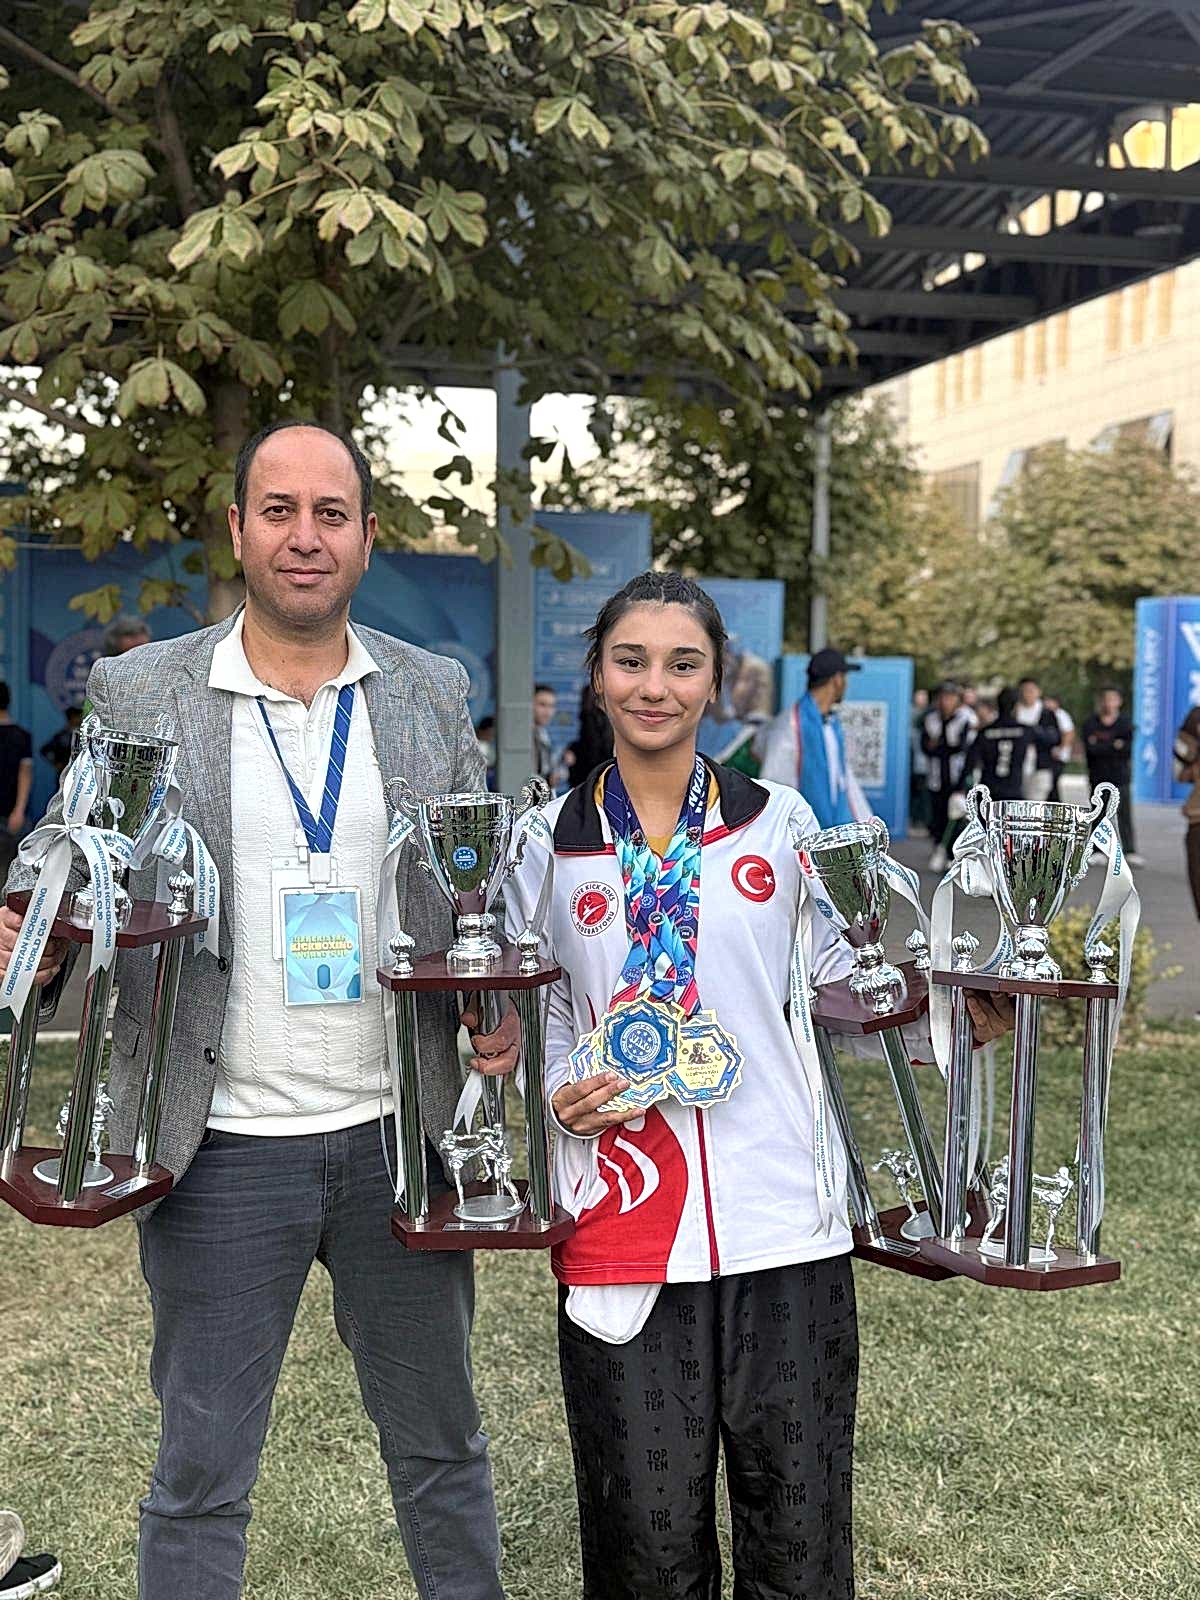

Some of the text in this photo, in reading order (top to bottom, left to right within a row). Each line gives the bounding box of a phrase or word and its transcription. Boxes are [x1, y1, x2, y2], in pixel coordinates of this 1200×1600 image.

[93, 863, 102, 898] WORLD
[208, 866, 216, 917] WORLD CUP
[602, 887, 615, 901] BOKS
[5, 887, 48, 996] UZBEKISTAN KICKBOXING
[25, 918, 48, 972] WORLD CUP
[291, 942, 353, 952] KICKBOXING
[680, 1359, 699, 1370] TOP
[776, 1361, 795, 1372] TOP
[681, 1370, 700, 1380] TEN
[777, 1372, 797, 1383] TEN
[645, 1389, 663, 1400] TOP
[645, 1400, 664, 1411] TEN
[684, 1416, 703, 1428] TOP
[782, 1421, 801, 1433] TOP
[684, 1427, 704, 1439] TEN
[783, 1433, 803, 1444] TEN
[647, 1449, 667, 1461] TOP
[647, 1461, 668, 1471] TEN
[785, 1483, 806, 1495] TOP
[786, 1495, 806, 1507] TEN
[650, 1509, 670, 1520] TOP
[651, 1520, 672, 1531] TEN
[786, 1540, 807, 1551] TOP
[787, 1551, 808, 1562] TEN
[656, 1566, 676, 1577] TOP
